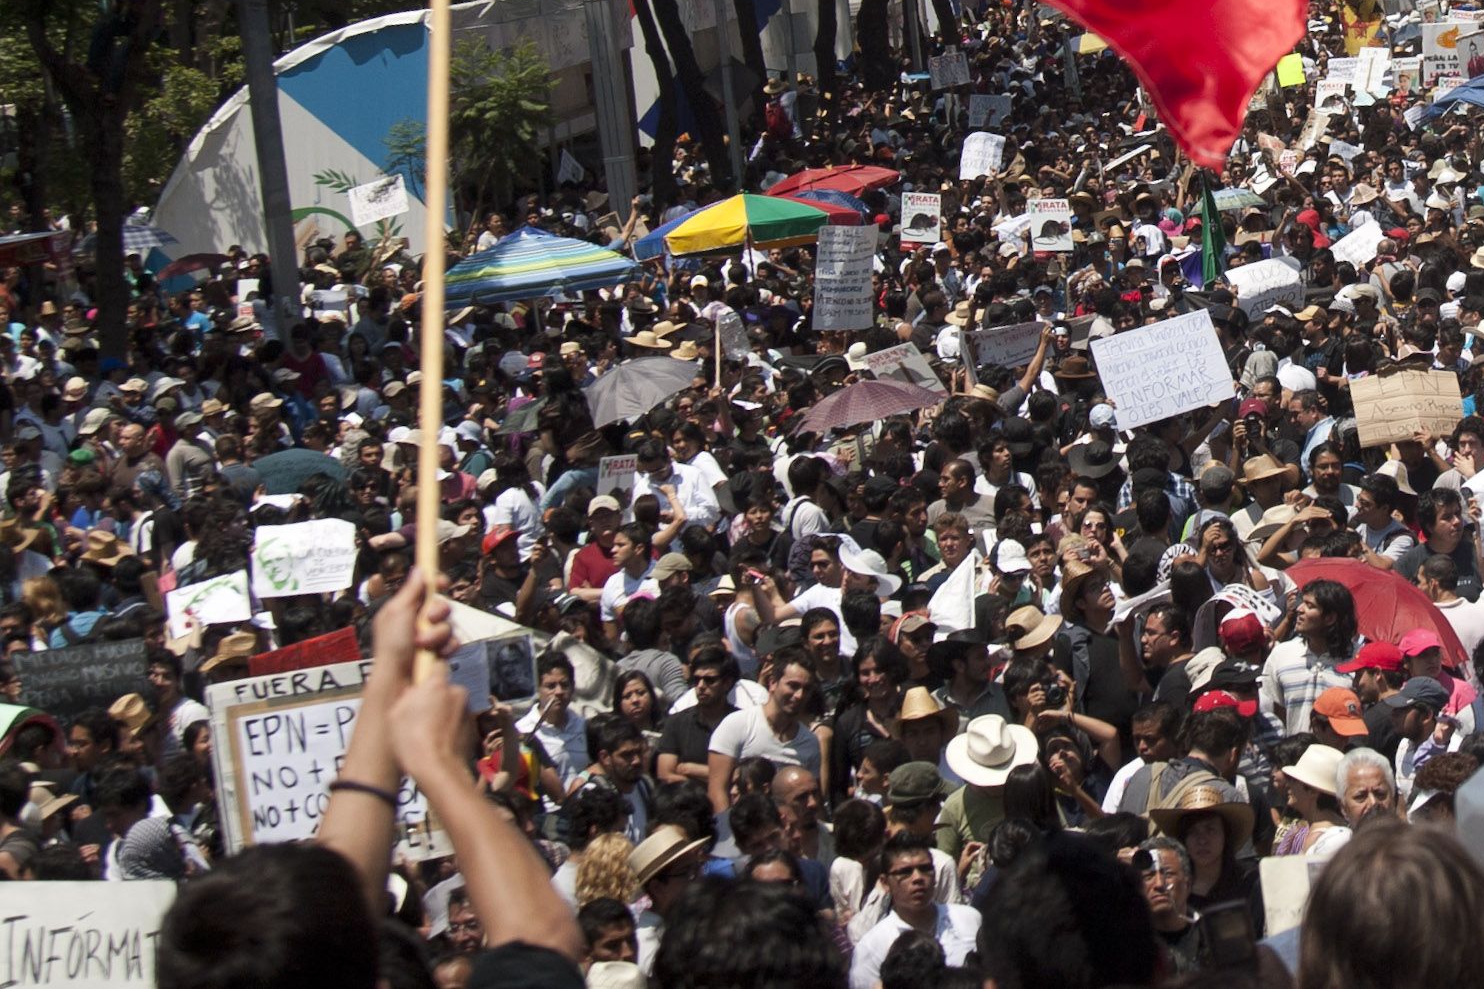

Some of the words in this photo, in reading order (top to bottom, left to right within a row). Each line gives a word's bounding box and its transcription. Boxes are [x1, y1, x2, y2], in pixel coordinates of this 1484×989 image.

[1117, 365, 1214, 411] INFORMAR
[1172, 382, 1213, 409] VALE?
[81, 661, 145, 682] MASIVO
[234, 668, 343, 703] FUERA
[245, 712, 307, 756] EPN
[335, 706, 355, 750] P
[252, 766, 298, 796] NO
[0, 911, 161, 989] INFÓRMAT
